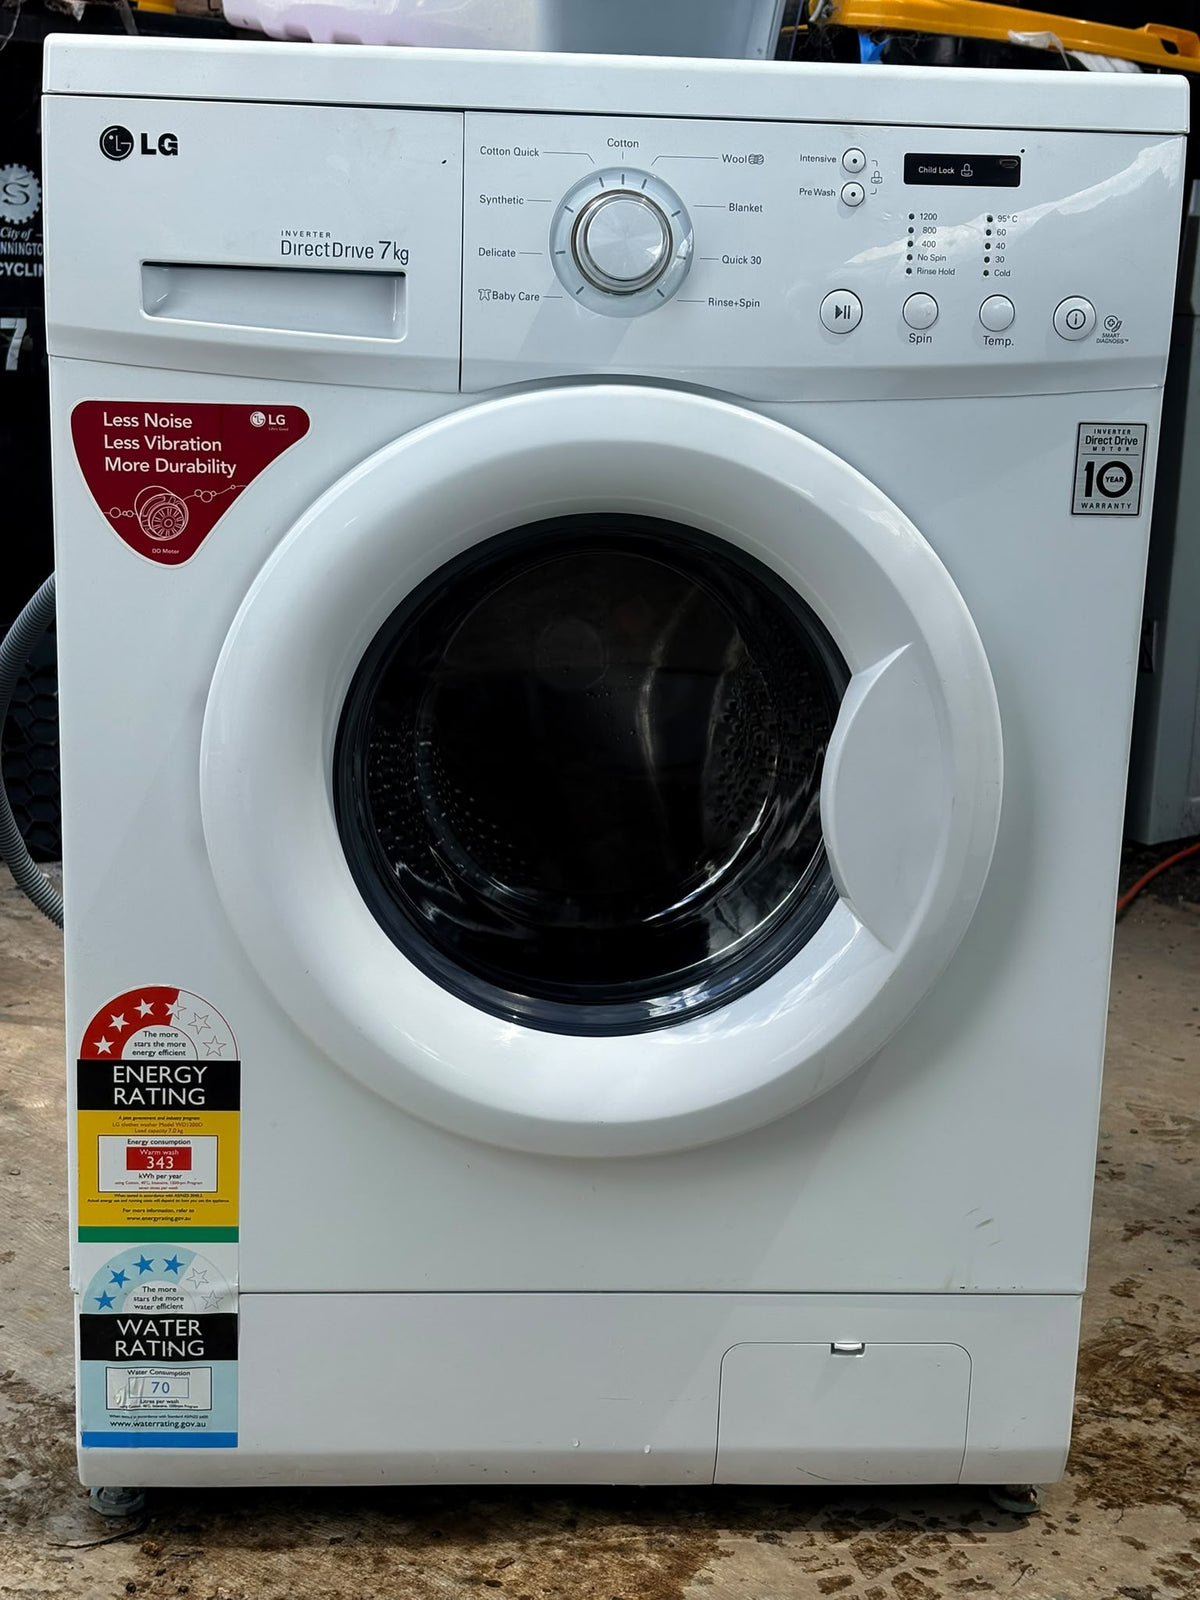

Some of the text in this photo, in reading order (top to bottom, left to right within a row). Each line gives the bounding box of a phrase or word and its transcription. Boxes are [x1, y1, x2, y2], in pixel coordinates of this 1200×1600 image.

[140, 133, 178, 156] LG
[606, 138, 640, 148] Cotton
[480, 146, 540, 157] Cotton Quick
[722, 154, 748, 164] Wool
[800, 154, 837, 163] Intensive
[918, 166, 955, 174] Child Lock
[479, 194, 524, 206] Synthetic
[728, 203, 764, 213] Blanket
[920, 212, 938, 221] 1200
[0, 226, 34, 241] City of
[280, 230, 332, 239] INVERTER
[922, 226, 937, 234] 800
[921, 240, 936, 248] 400
[996, 242, 1006, 250] 40
[478, 247, 516, 258] Delicate
[722, 254, 762, 265] Quick 30
[917, 254, 947, 263] No Spin
[994, 256, 1005, 264] 30
[916, 266, 956, 276] Rinse Hold
[994, 269, 1011, 278] Cold
[492, 291, 540, 302] Baby Care
[708, 298, 761, 309] Rinse+Spin
[908, 333, 932, 346] Spin
[982, 335, 1015, 347] Temp.
[103, 412, 192, 429] Less Noise
[268, 414, 286, 426] LG
[104, 434, 222, 452] Less Vibration
[1085, 435, 1138, 446] Direct Drive
[104, 456, 236, 478] More Durability
[1084, 460, 1134, 498] 10
[113, 1066, 208, 1084] ENERGY
[114, 1088, 206, 1106] RATING
[146, 1156, 174, 1170] 343
[116, 1320, 202, 1336] WATER
[115, 1340, 204, 1358] RATING
[152, 1382, 170, 1394] 70
[110, 1420, 206, 1429] www.waterrating.gov.au
